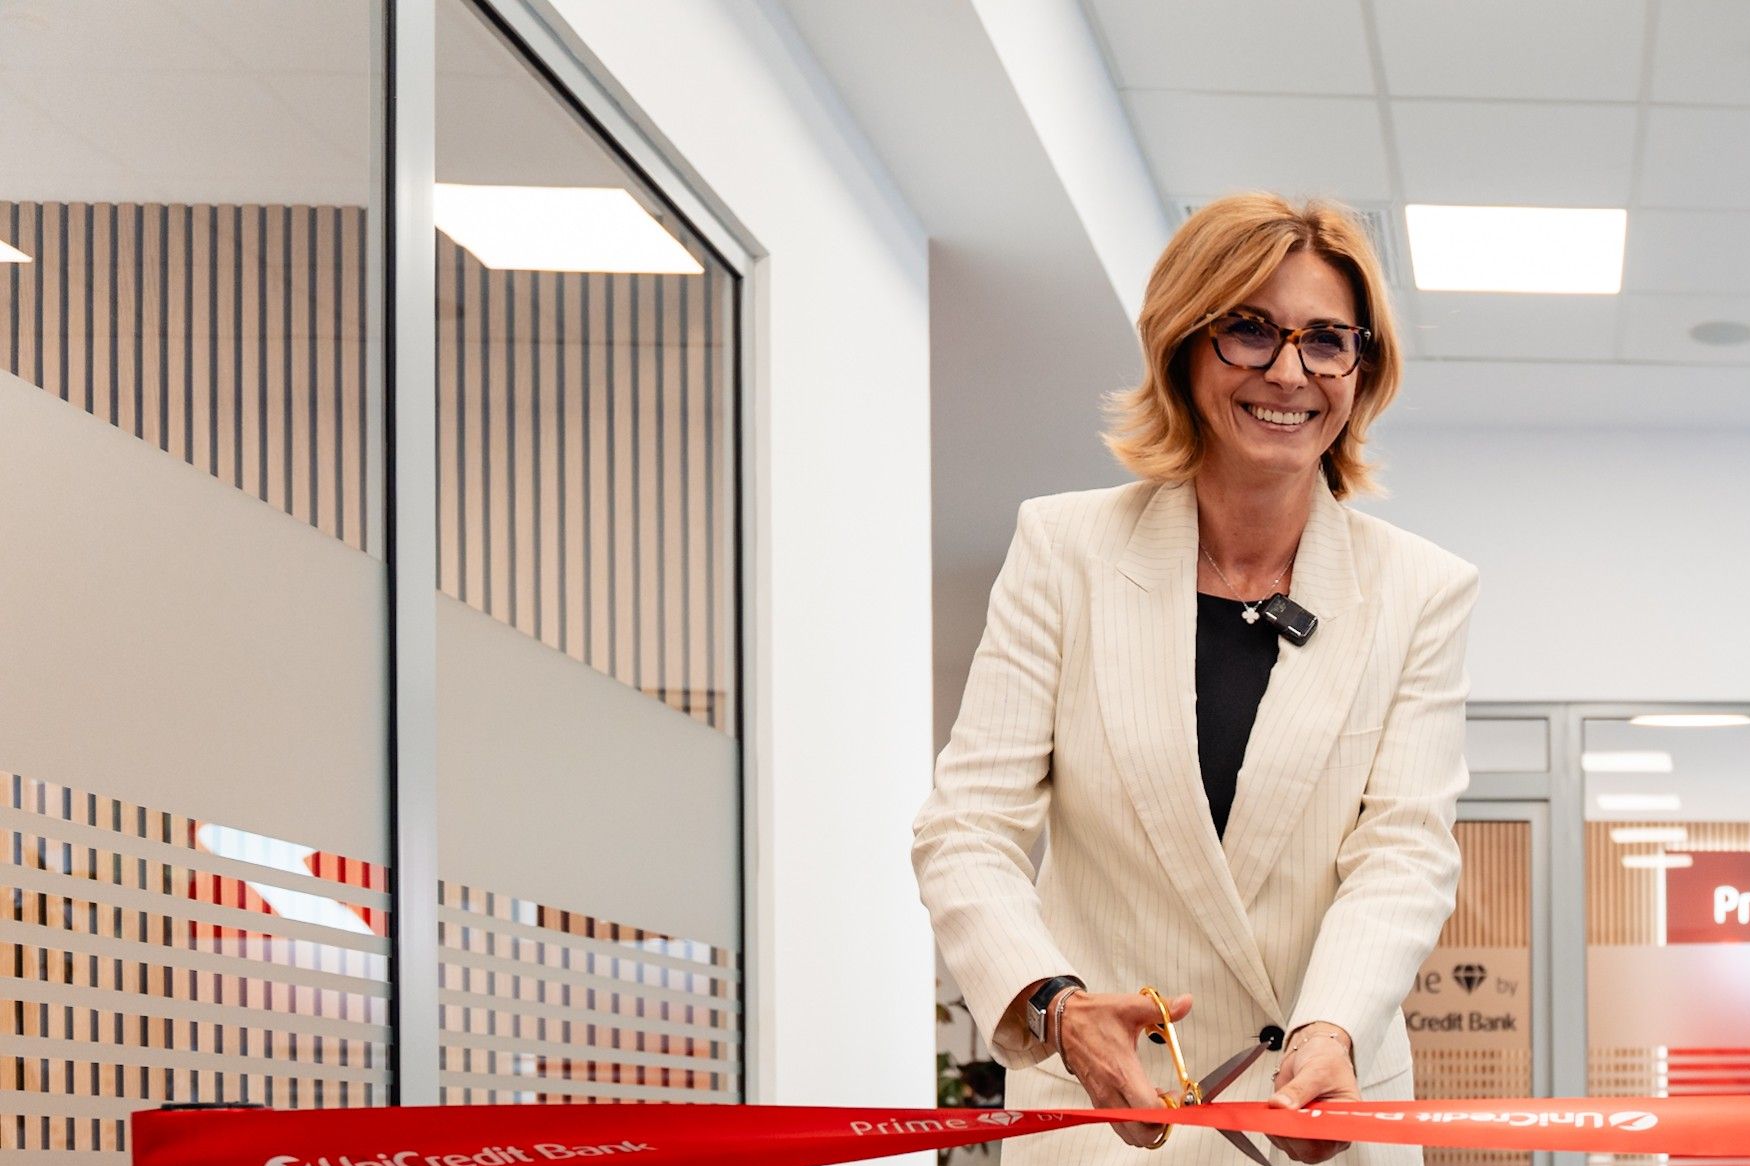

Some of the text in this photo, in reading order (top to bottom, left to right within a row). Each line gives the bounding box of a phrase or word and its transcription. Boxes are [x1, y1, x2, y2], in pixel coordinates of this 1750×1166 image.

[1496, 977, 1518, 997] by
[1405, 1009, 1517, 1032] Credit Bank
[850, 1117, 966, 1136] Prime
[533, 1140, 658, 1161] Bank
